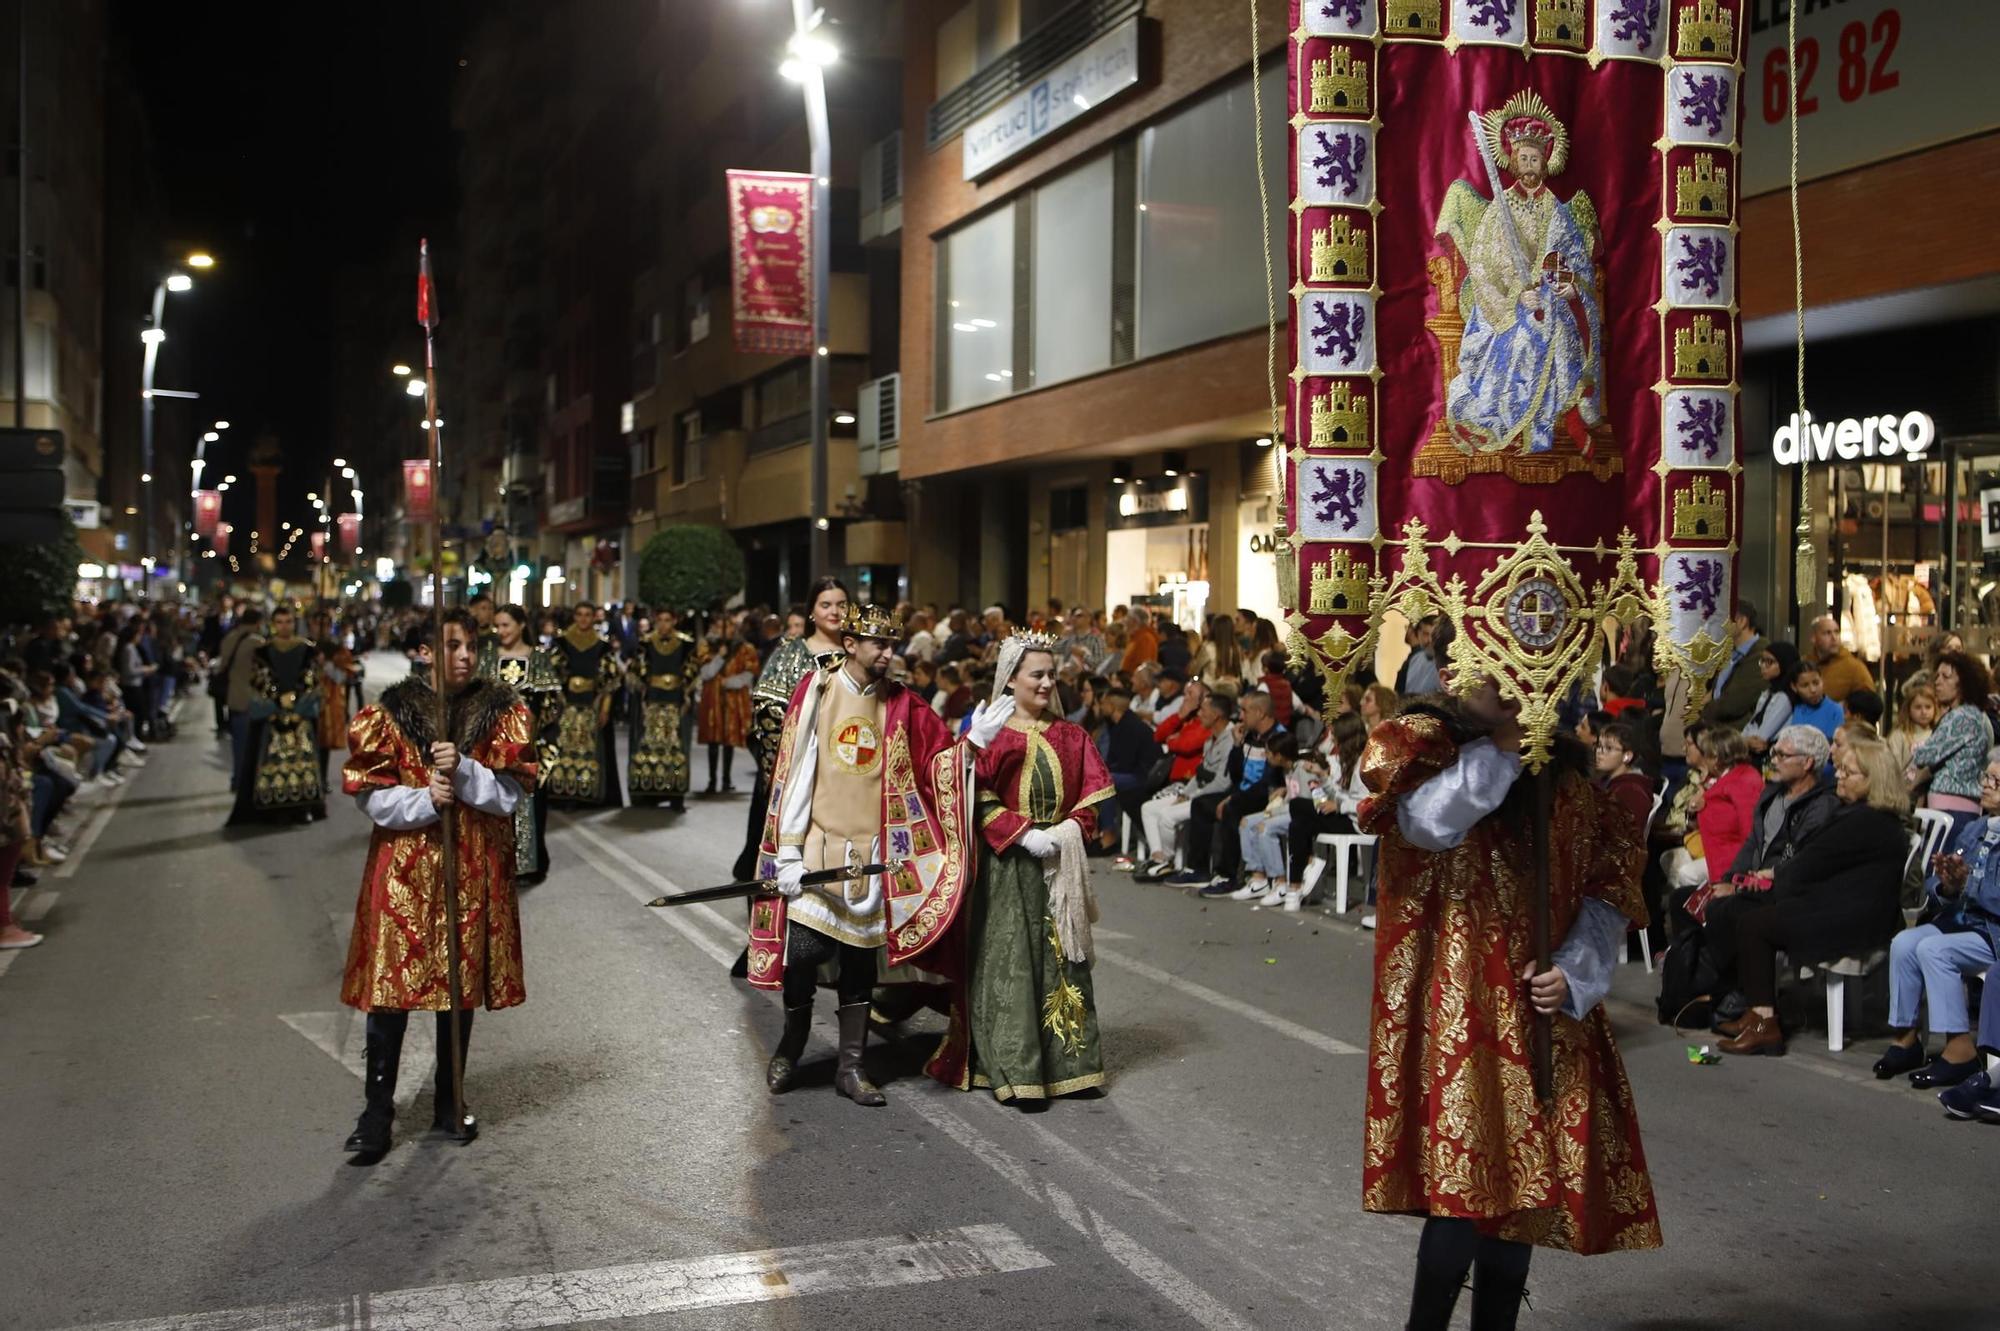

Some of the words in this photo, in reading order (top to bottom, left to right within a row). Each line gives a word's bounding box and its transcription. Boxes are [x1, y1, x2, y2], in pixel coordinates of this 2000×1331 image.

[1763, 36, 1820, 125] 62
[1838, 8, 1901, 104] 82
[969, 100, 1028, 154] virtud
[1773, 410, 1934, 465] diverso
